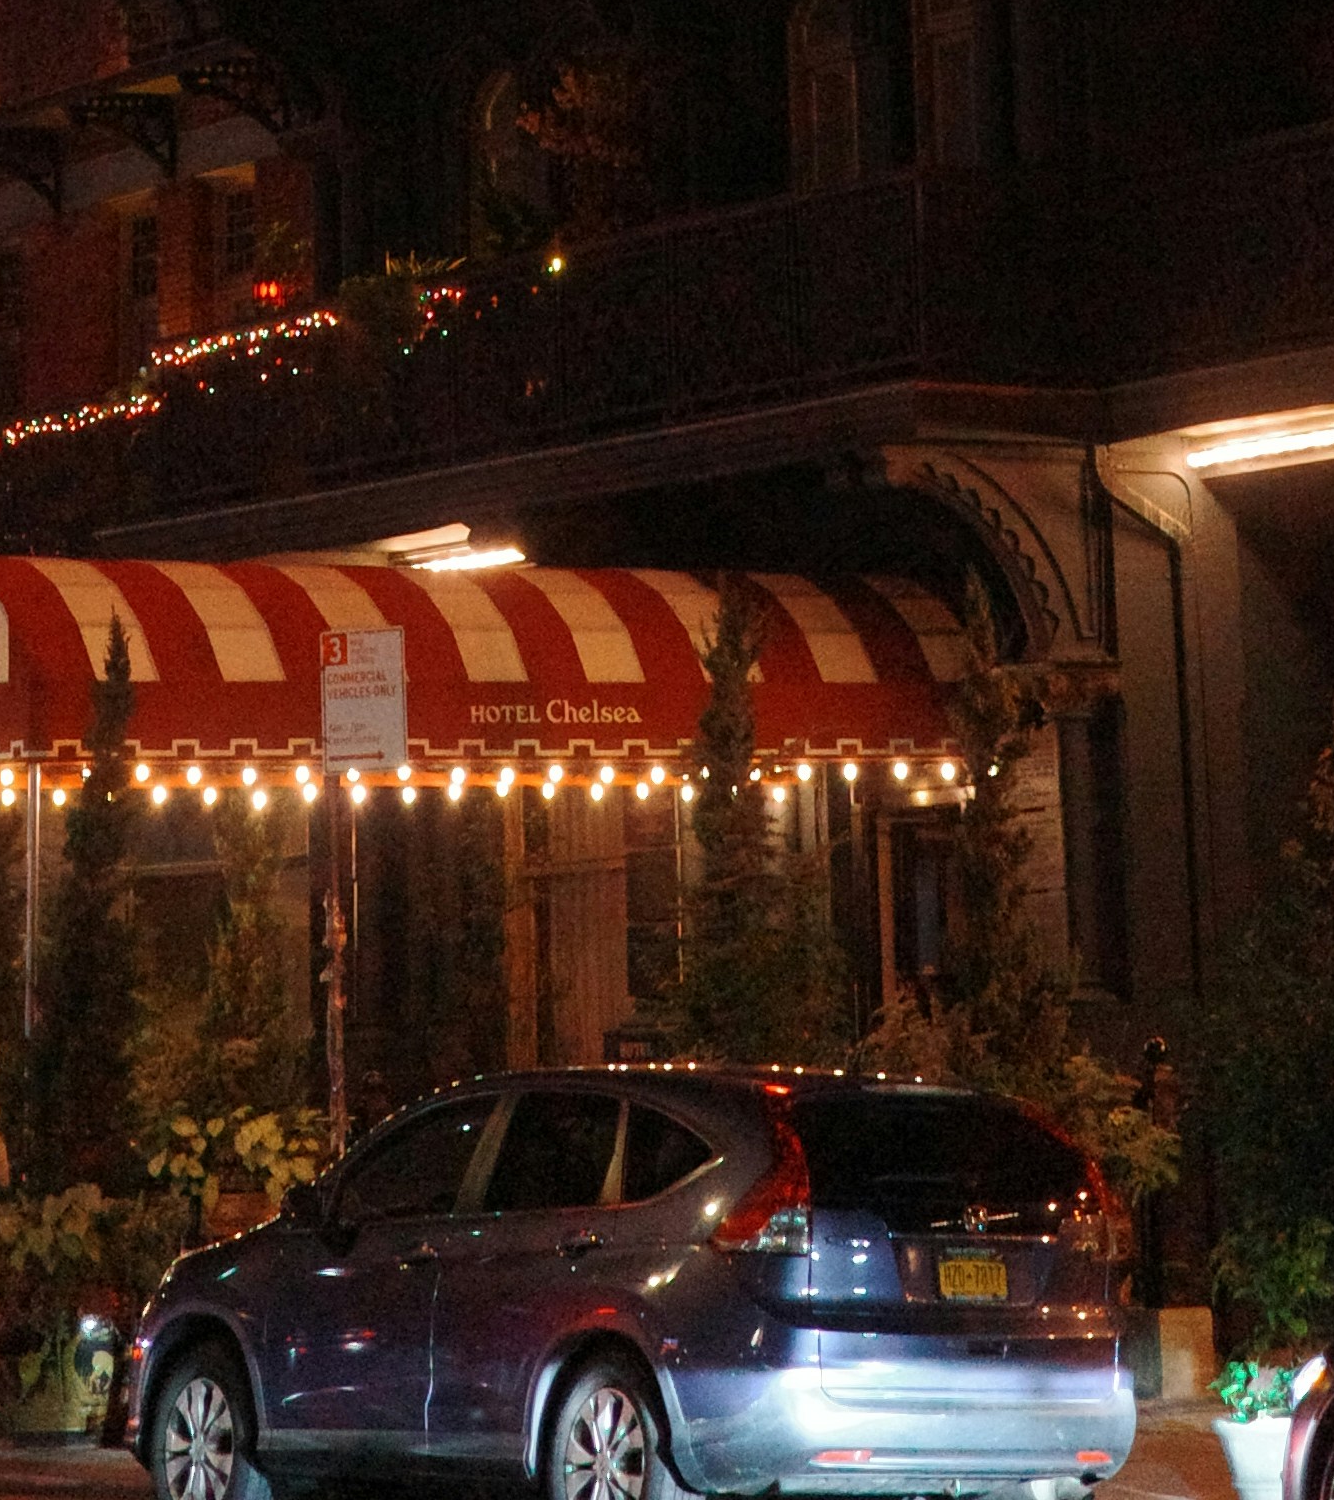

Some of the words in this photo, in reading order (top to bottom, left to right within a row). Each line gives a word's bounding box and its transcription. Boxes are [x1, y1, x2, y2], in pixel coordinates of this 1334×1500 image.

[329, 637, 342, 663] 3
[327, 670, 387, 684] COMMERCIAL
[373, 684, 396, 697] ONLY
[470, 705, 541, 723] HOTEL
[546, 699, 643, 723] Chelsea
